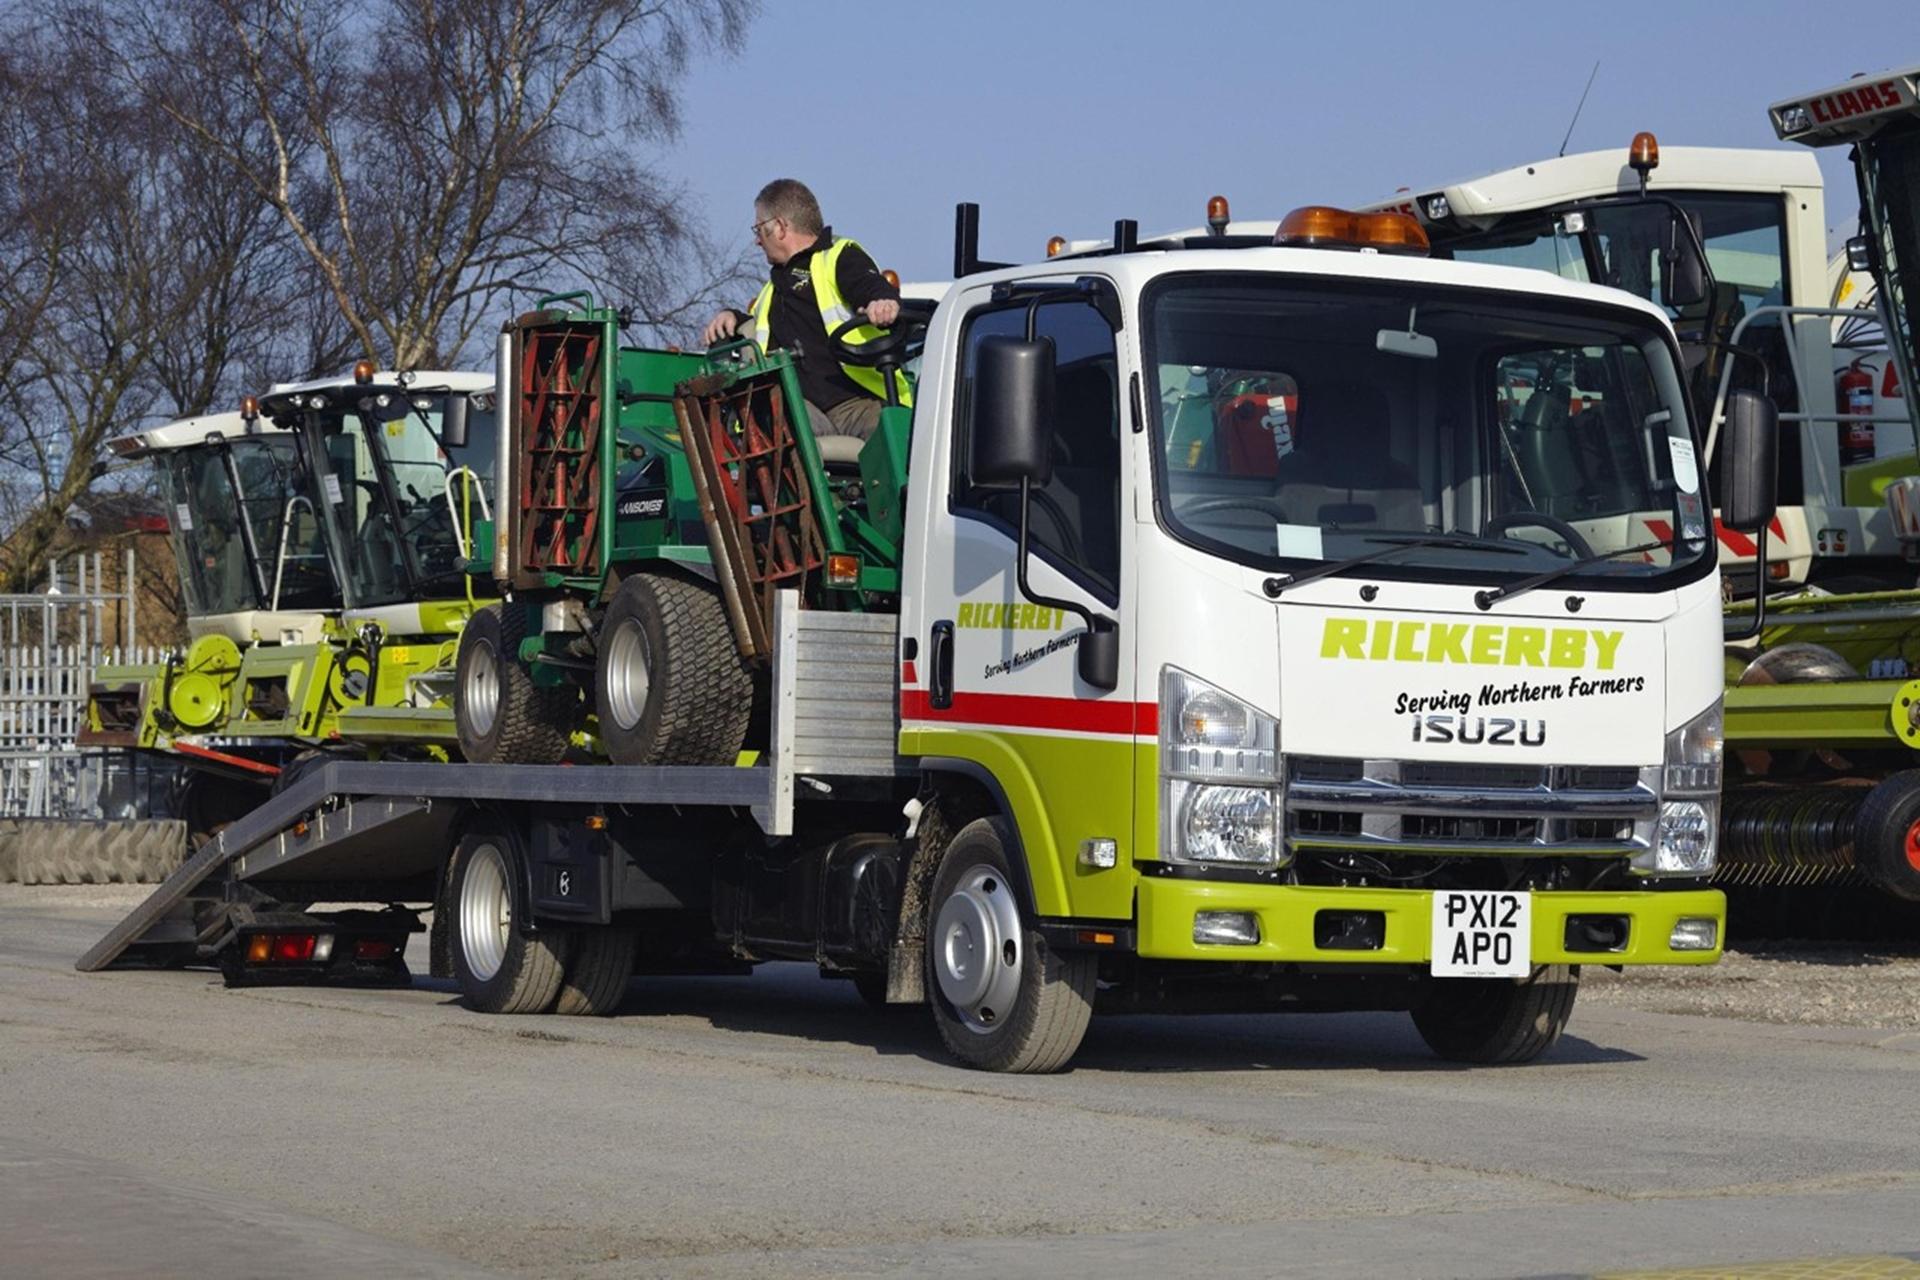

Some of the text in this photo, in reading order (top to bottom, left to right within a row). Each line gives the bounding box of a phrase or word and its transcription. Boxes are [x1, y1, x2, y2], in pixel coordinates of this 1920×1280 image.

[1809, 81, 1902, 123] CLAAS
[957, 602, 1065, 631] RICKERBY
[984, 634, 1079, 679] Serving Northern Farmers
[1320, 618, 1624, 669] RICKERBY
[1395, 676, 1645, 714] Serving Northern Farmers
[1412, 714, 1546, 747] ISUZU
[1448, 894, 1518, 928] PX12
[1451, 931, 1512, 965] APO
